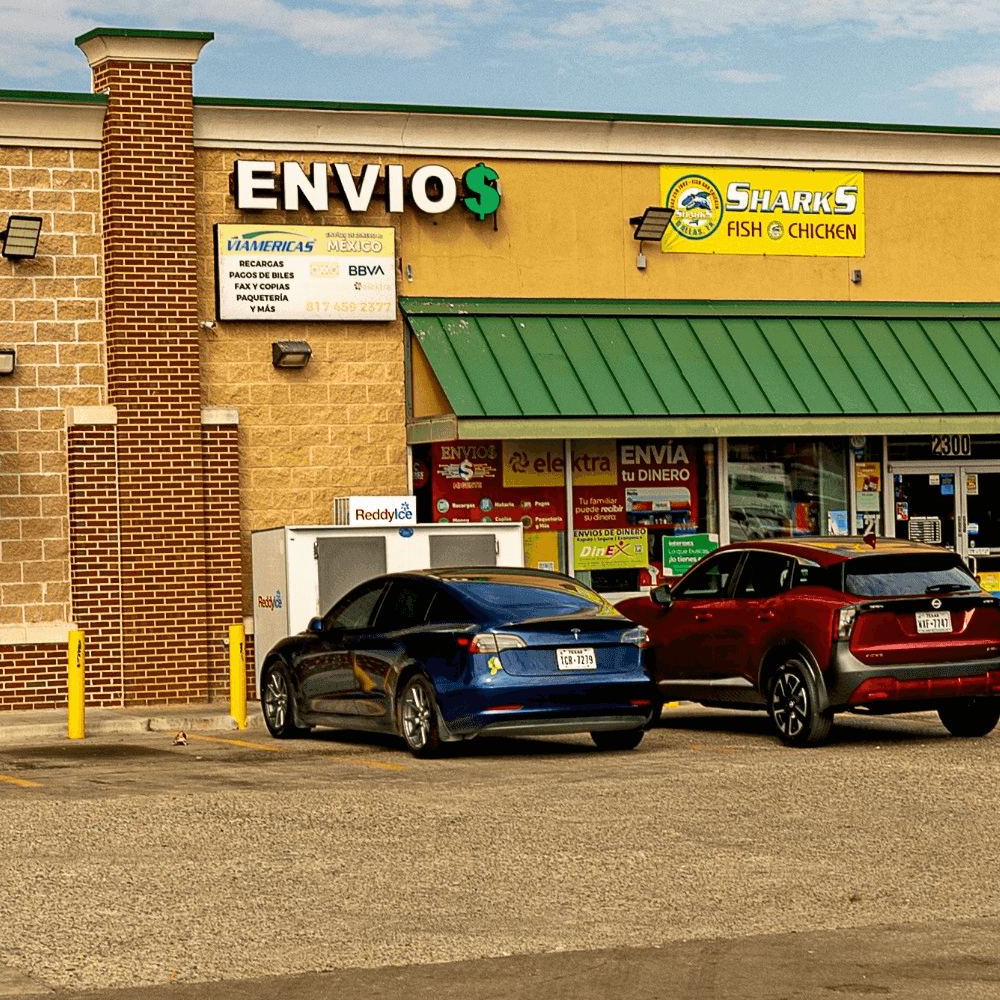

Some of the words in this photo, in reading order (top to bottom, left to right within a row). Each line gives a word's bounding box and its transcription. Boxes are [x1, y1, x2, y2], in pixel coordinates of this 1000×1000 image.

[725, 182, 858, 215] SHARKS
[727, 220, 762, 237] FISH
[788, 222, 857, 240] CHICKEN
[227, 239, 315, 252] VIAMERICAS
[327, 237, 383, 253] MÉXICO
[239, 260, 284, 268] RECARGAS
[229, 271, 258, 279] PAGOS
[259, 271, 270, 279] DE
[272, 271, 295, 279] BILES
[348, 265, 385, 276] BBVA
[236, 293, 289, 302] PAQUETERÍA
[257, 304, 276, 312] MÁS
[932, 435, 971, 456] 2300
[621, 440, 690, 464] ENVÍA
[622, 470, 635, 482] tu
[638, 468, 691, 482] DINERO
[579, 497, 589, 505] Tu
[355, 507, 412, 522] ReddyIce
[575, 507, 600, 515] puede
[601, 505, 624, 513] recibir
[573, 529, 603, 537] ENVIOS
[616, 528, 646, 536] DINERO
